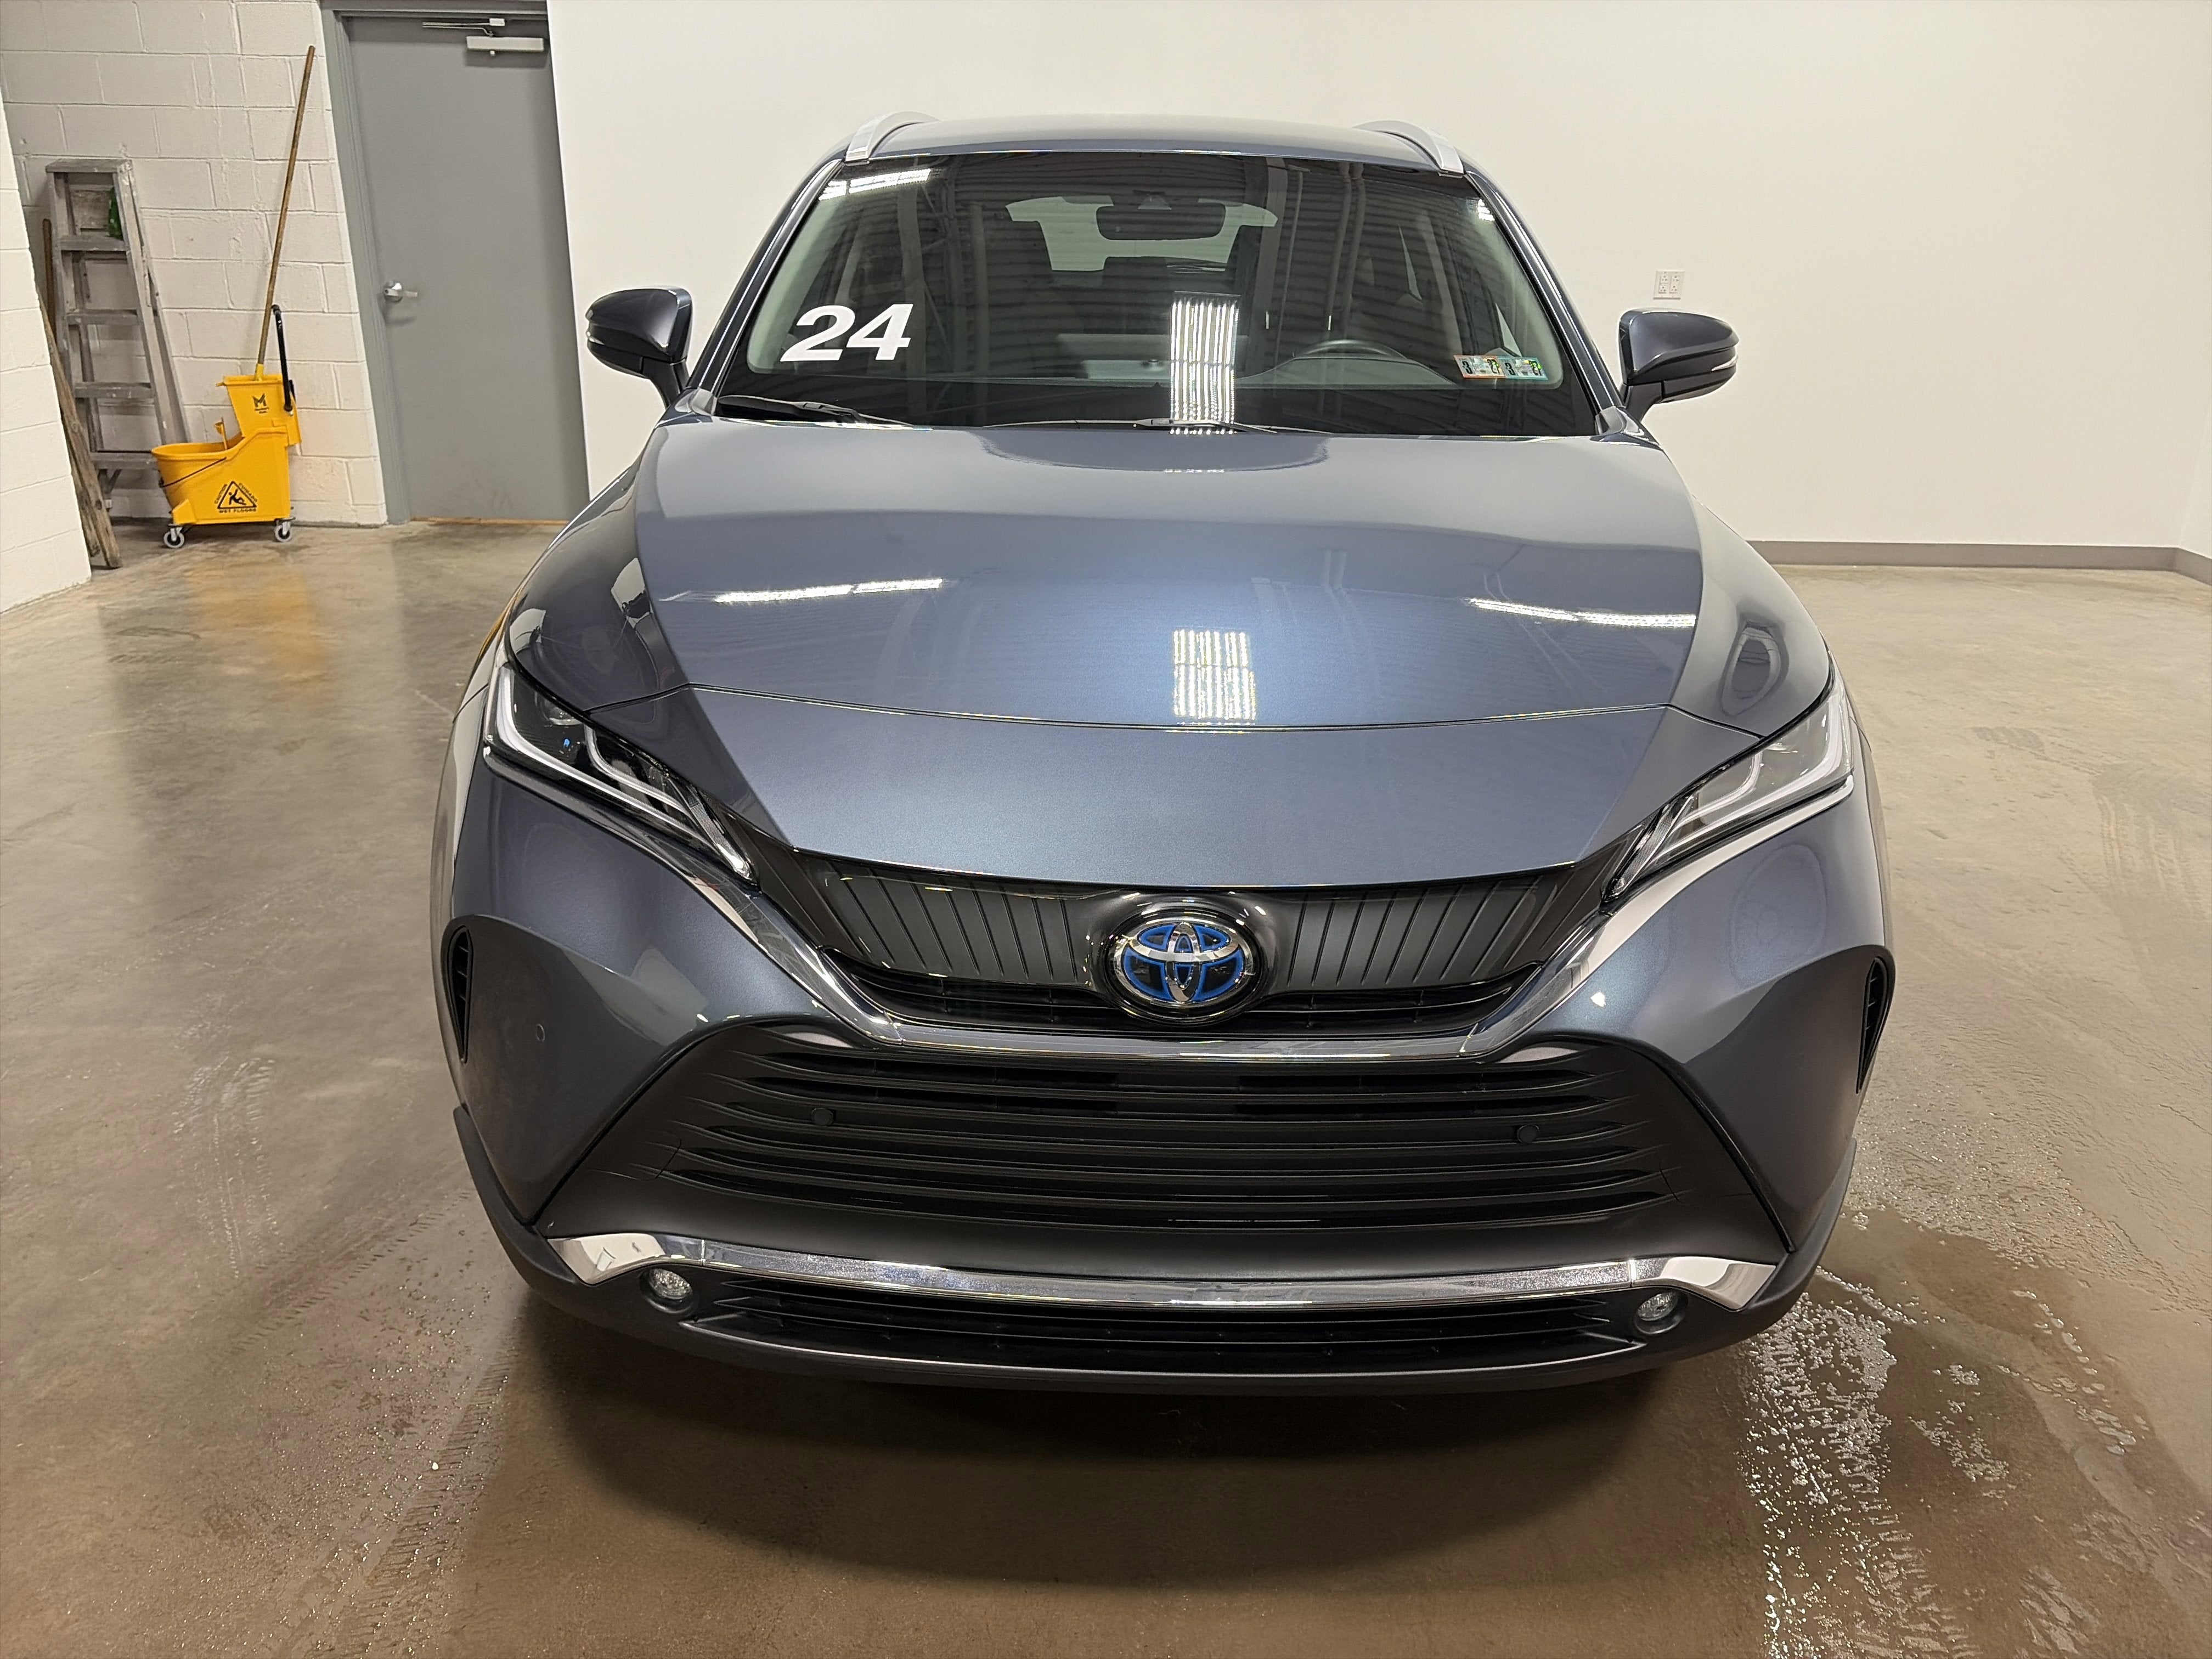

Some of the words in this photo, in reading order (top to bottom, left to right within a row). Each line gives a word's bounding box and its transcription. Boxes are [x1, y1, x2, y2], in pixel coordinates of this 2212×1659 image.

[780, 303, 913, 362] 24
[1462, 360, 1473, 374] 3
[1504, 362, 1516, 375] 3
